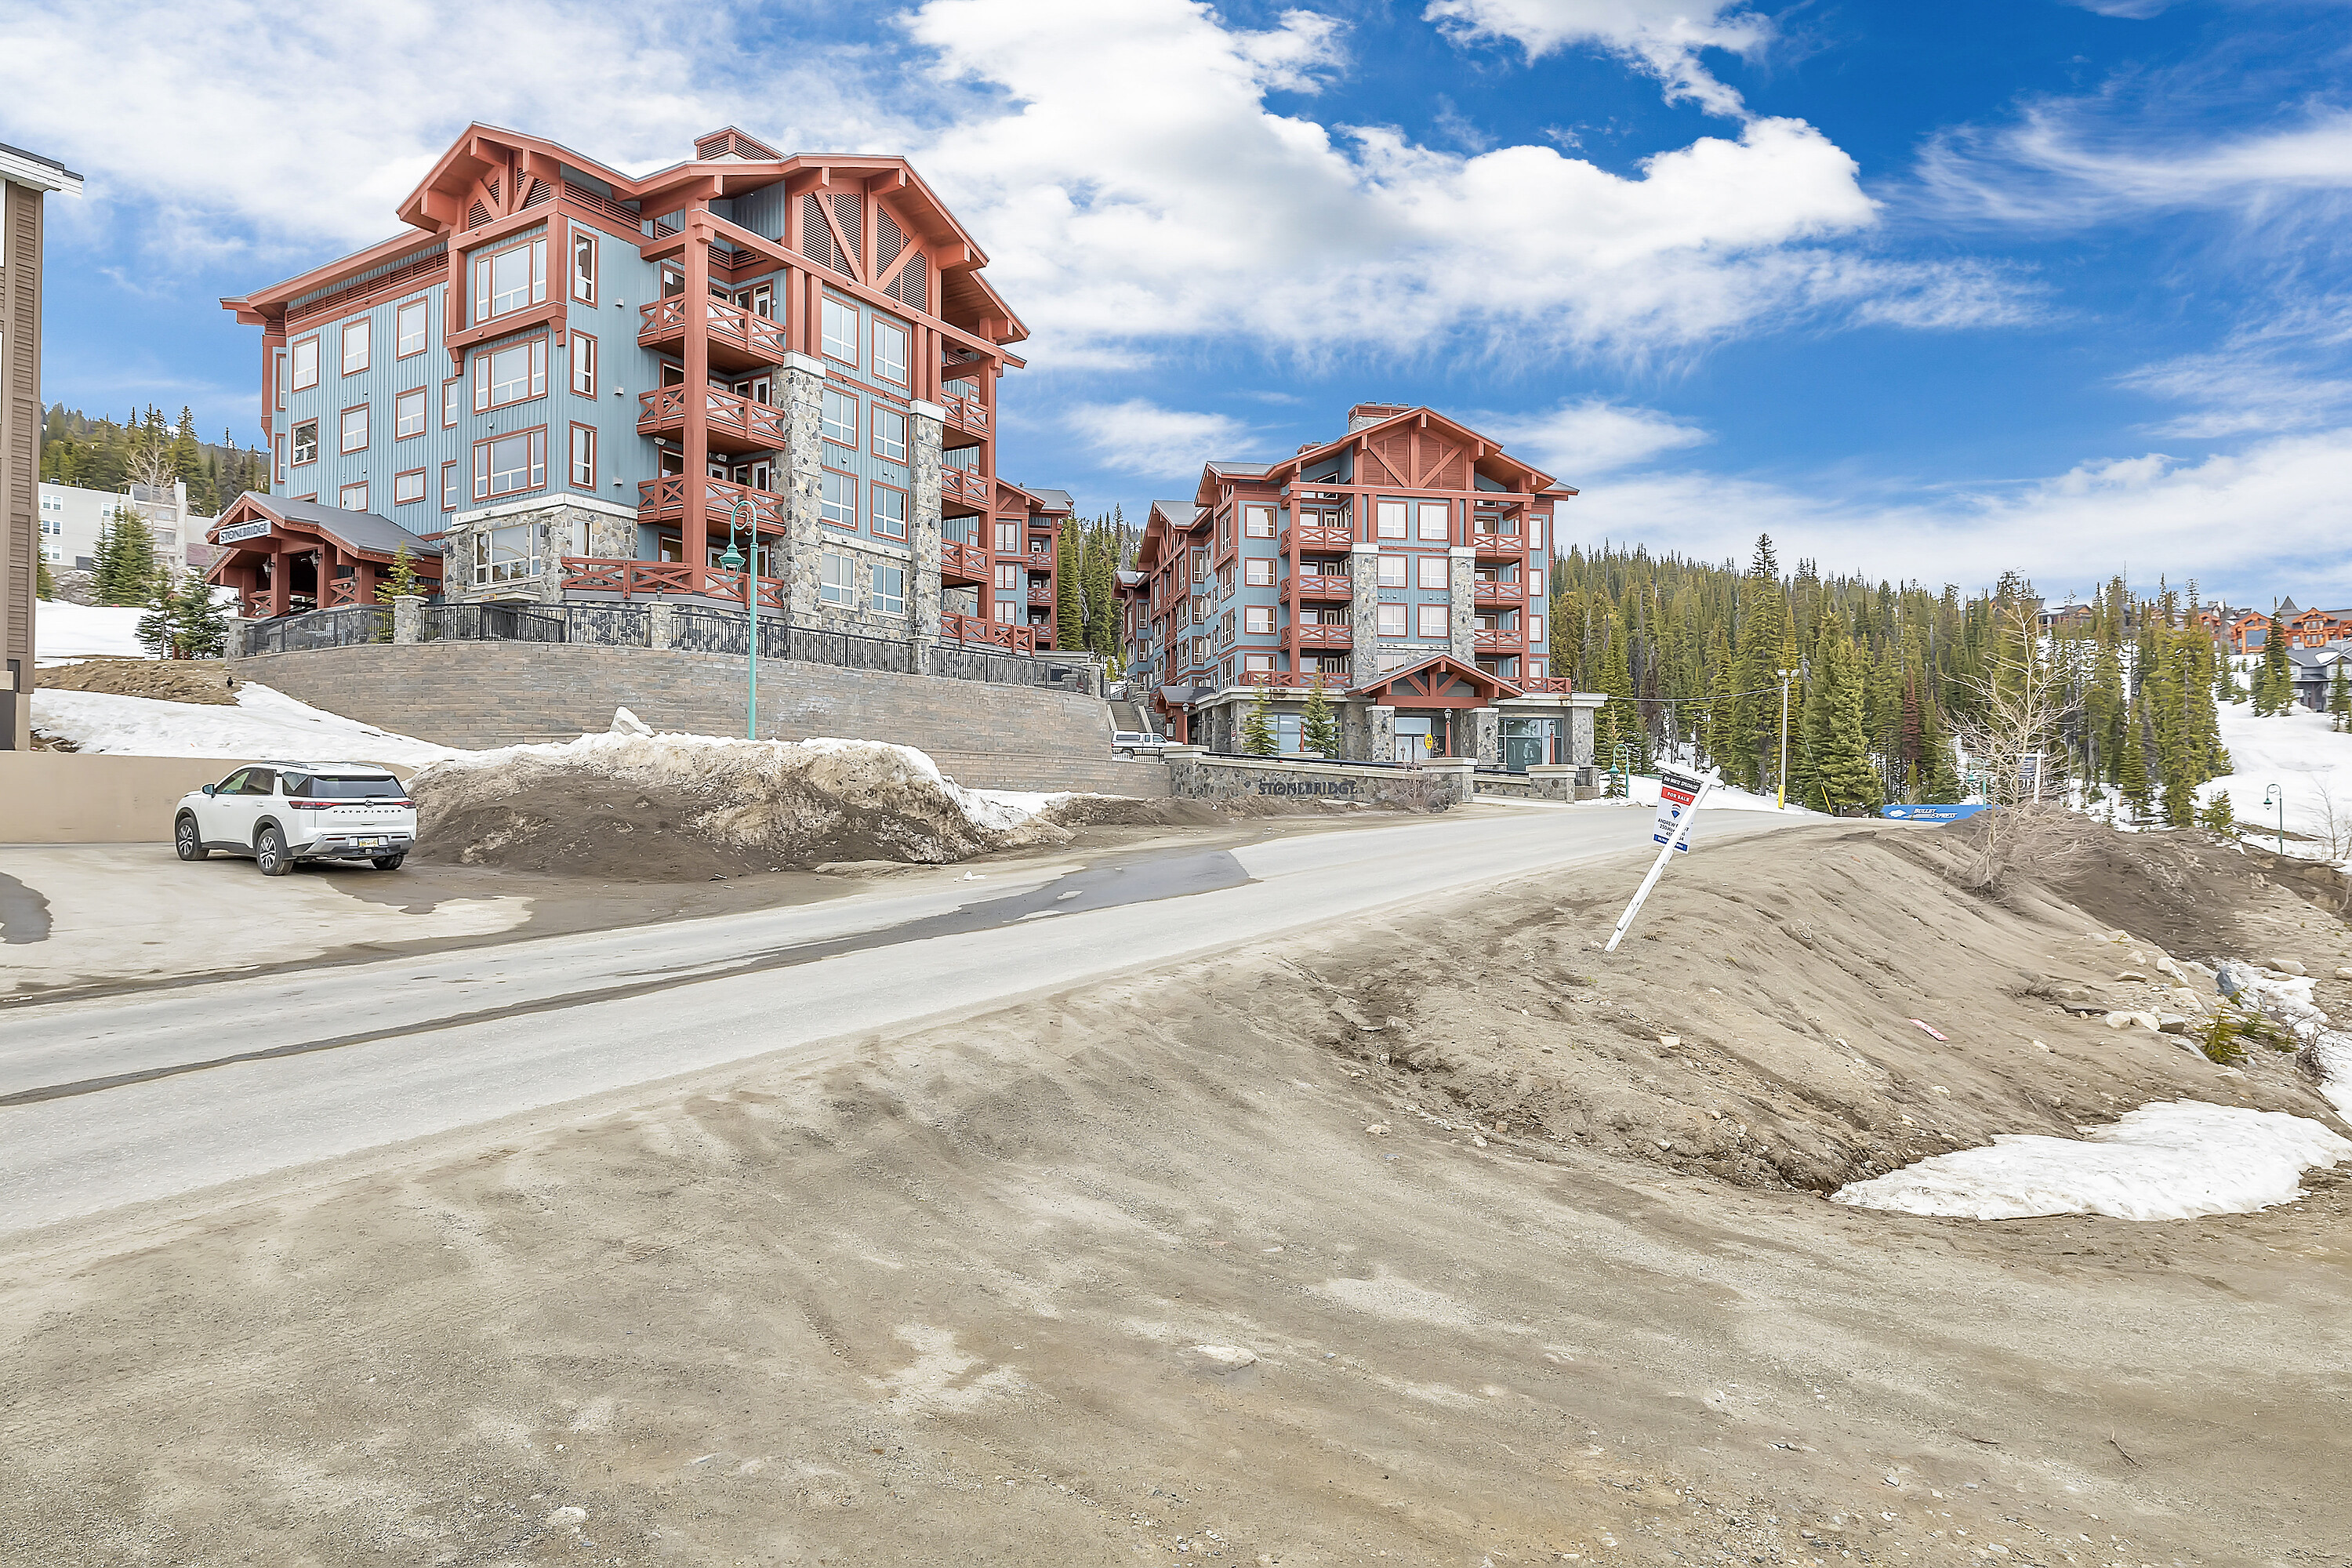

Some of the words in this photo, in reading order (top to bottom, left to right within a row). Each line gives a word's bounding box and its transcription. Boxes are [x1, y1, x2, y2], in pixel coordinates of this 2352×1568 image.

[220, 523, 268, 542] STONEBRIDGE
[1258, 780, 1358, 796] STONEBRIDGE
[1657, 818, 1675, 827] ANDREW
